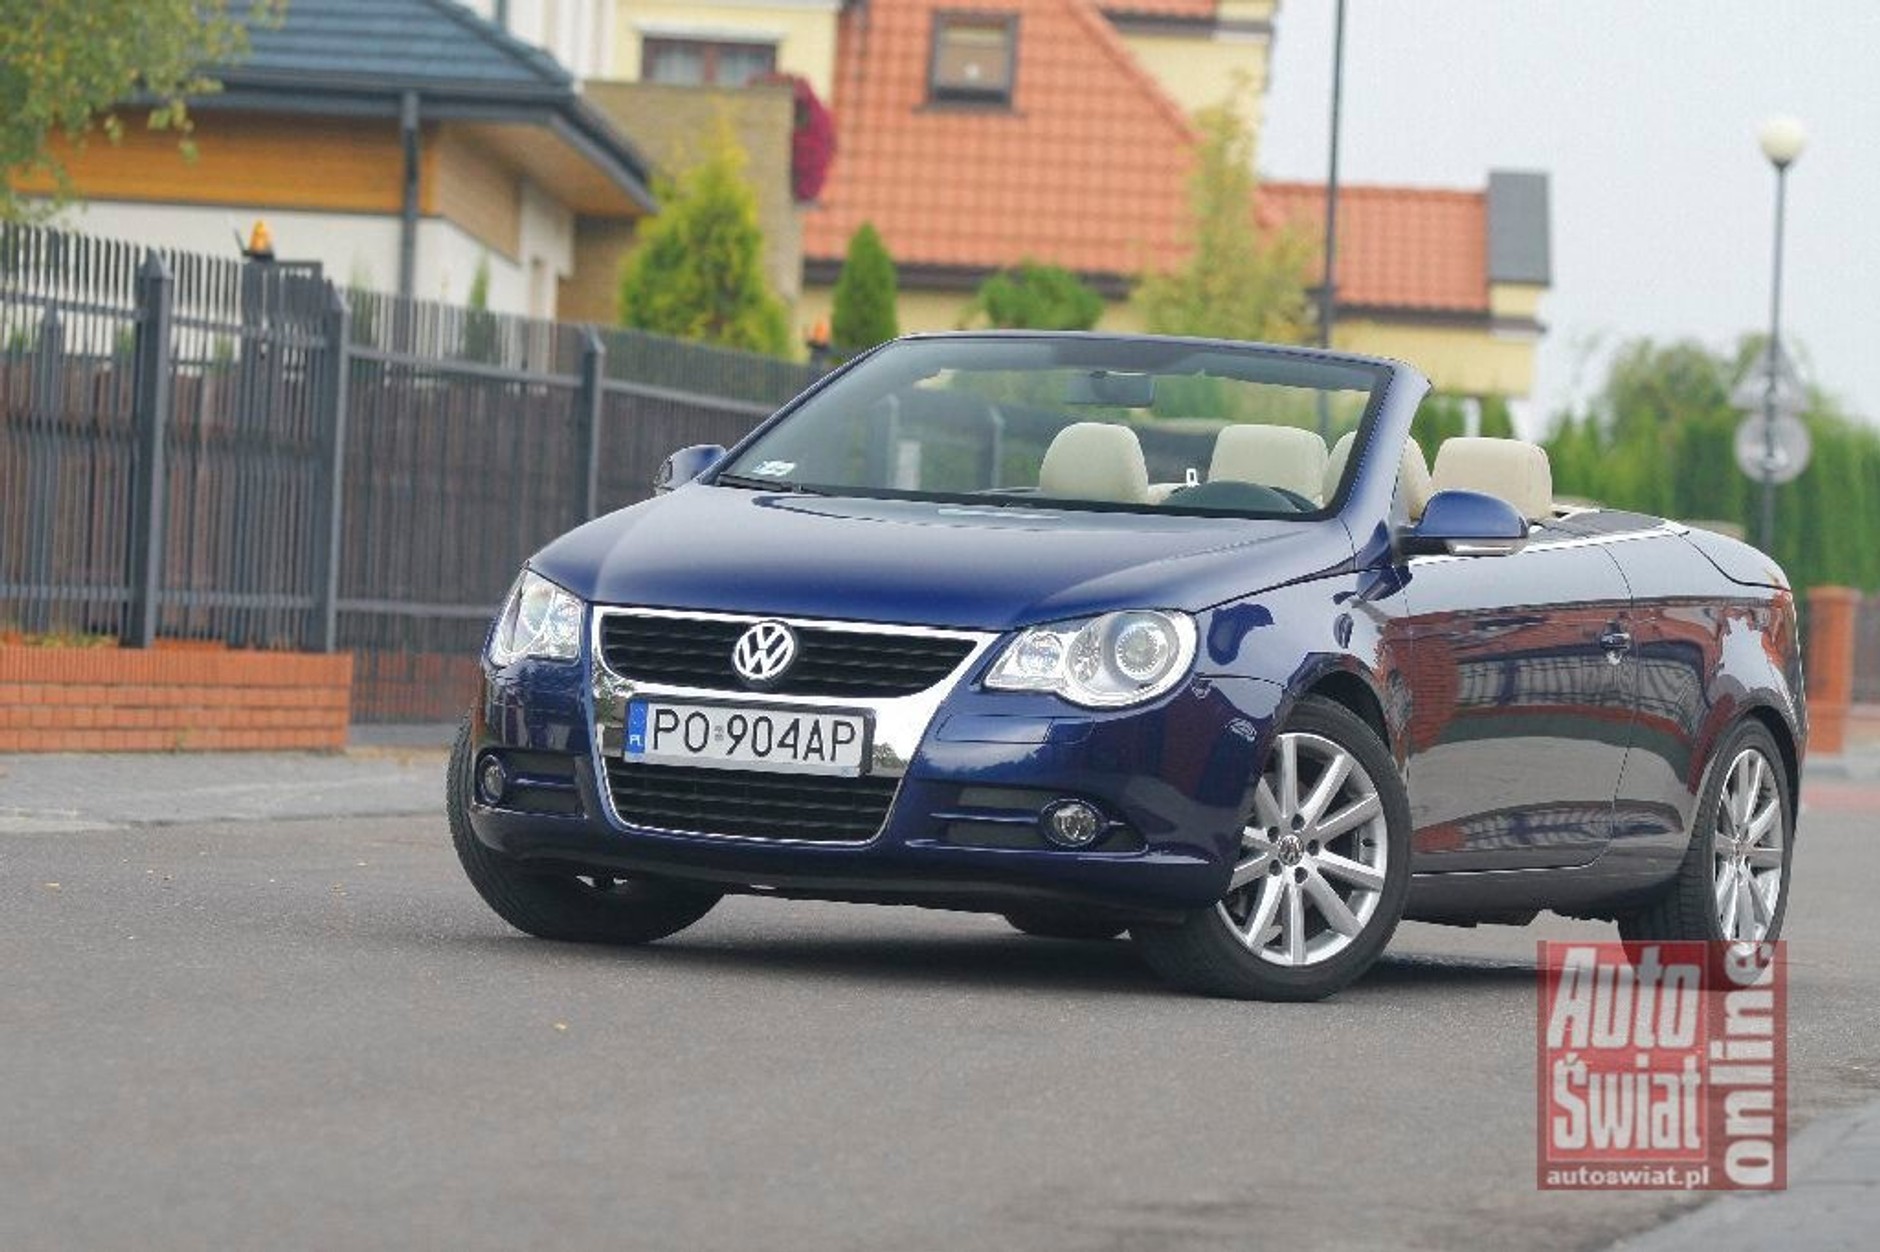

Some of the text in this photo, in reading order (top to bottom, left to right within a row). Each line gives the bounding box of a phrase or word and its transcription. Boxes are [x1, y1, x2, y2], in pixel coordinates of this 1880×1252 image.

[629, 734, 644, 747] PL
[652, 708, 856, 762] PO 904AP
